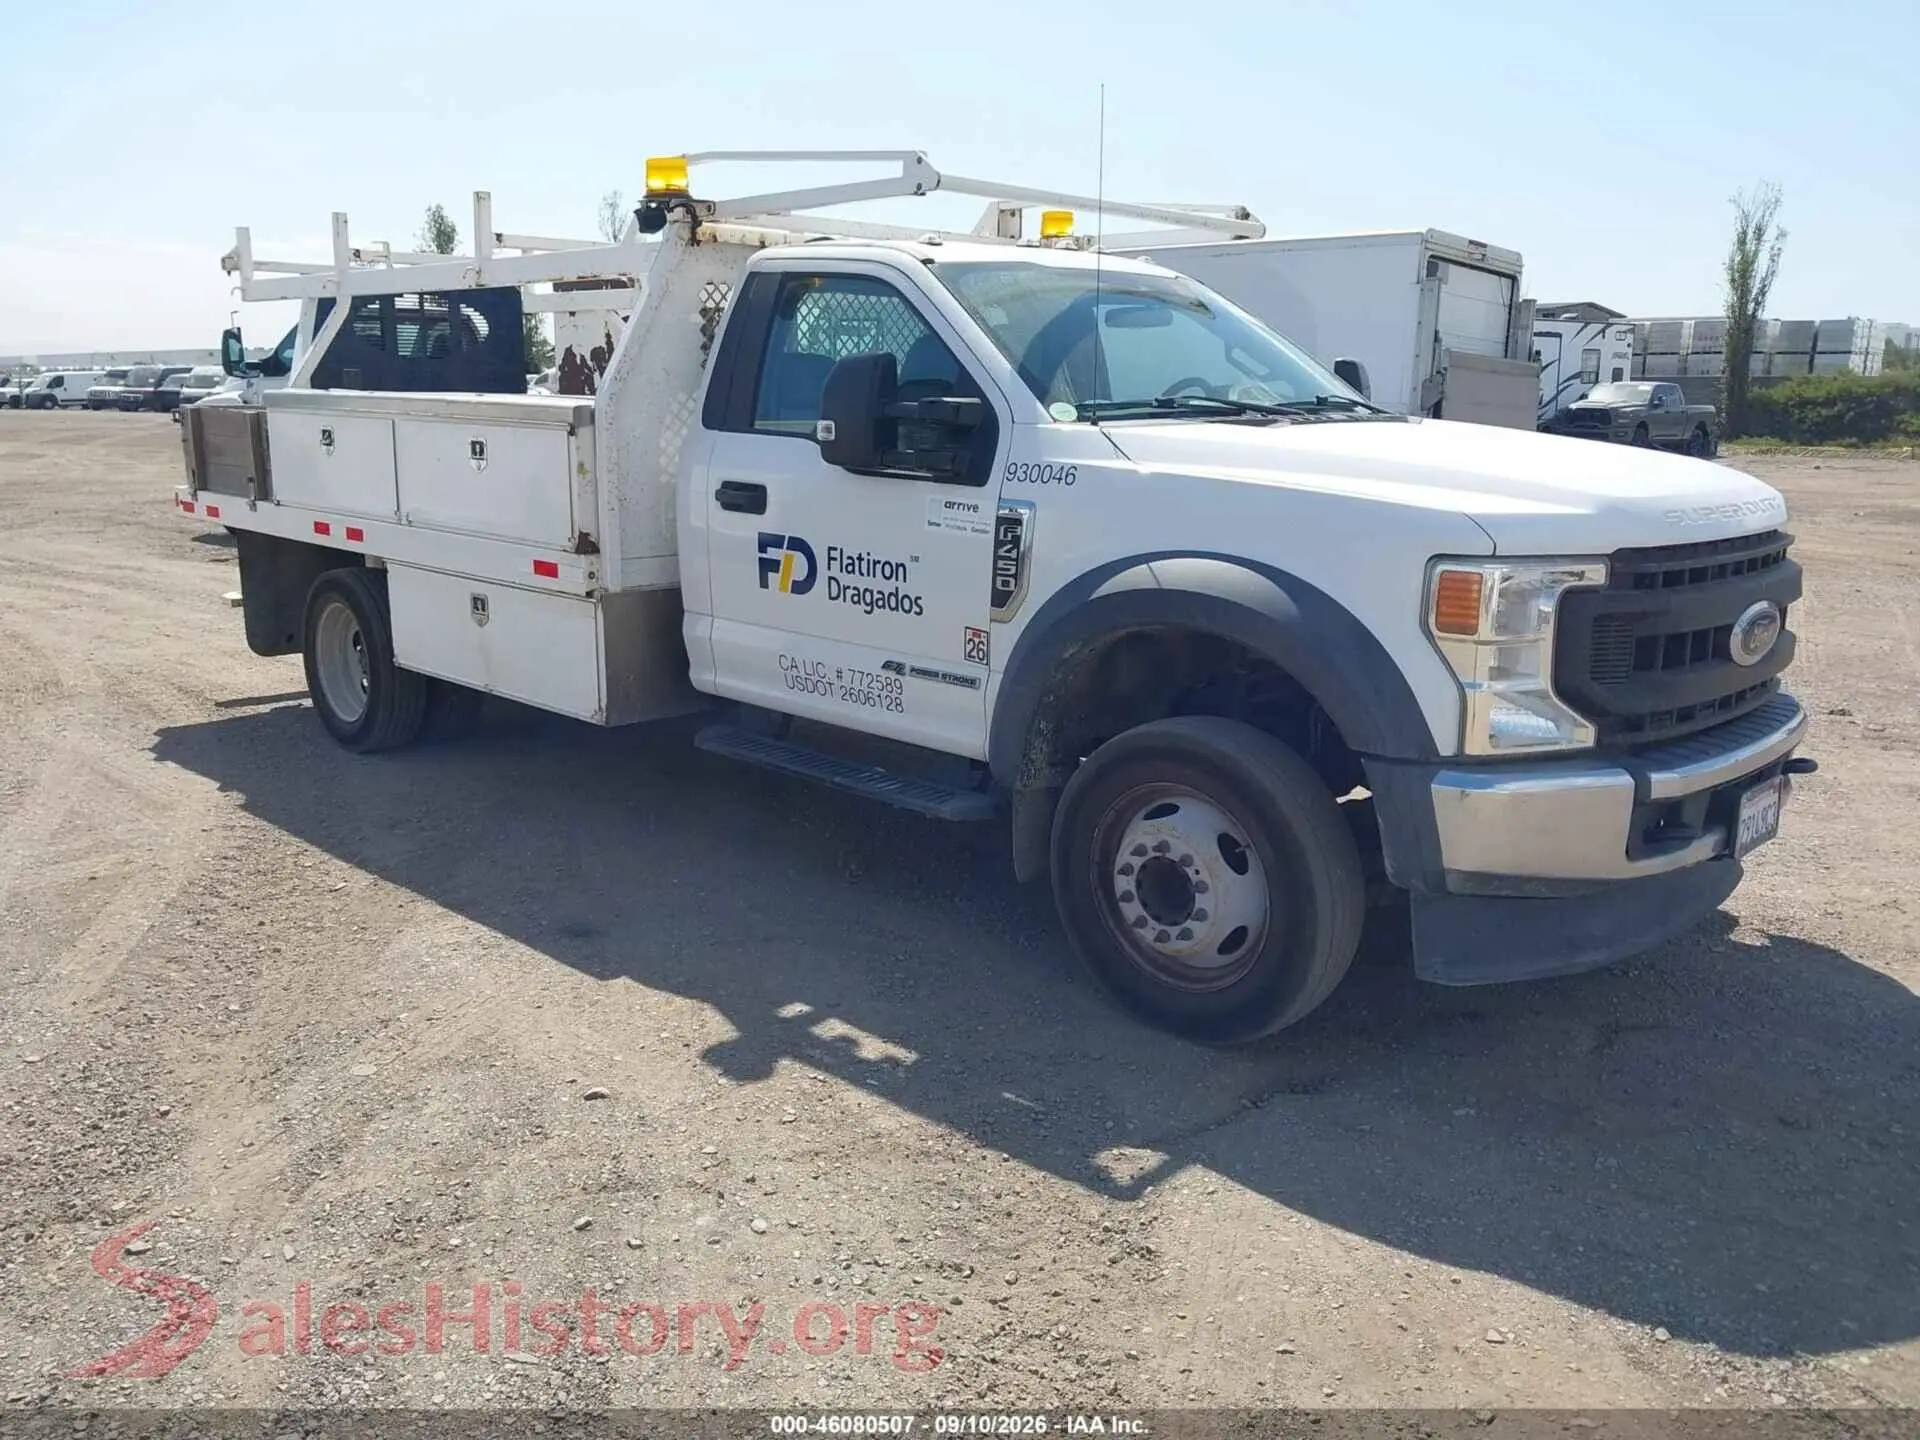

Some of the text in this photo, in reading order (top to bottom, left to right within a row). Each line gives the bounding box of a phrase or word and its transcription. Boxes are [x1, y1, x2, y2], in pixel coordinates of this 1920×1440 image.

[1006, 462, 1078, 486] 930046
[944, 500, 980, 513] arrive
[827, 546, 907, 583] Flatiron
[827, 576, 924, 616] Dragados
[967, 638, 986, 662] 26
[778, 654, 799, 671] CA
[803, 659, 832, 681] LIC.
[836, 668, 844, 682] #
[848, 668, 904, 696] 772589
[784, 674, 905, 714] USDOT 2606128
